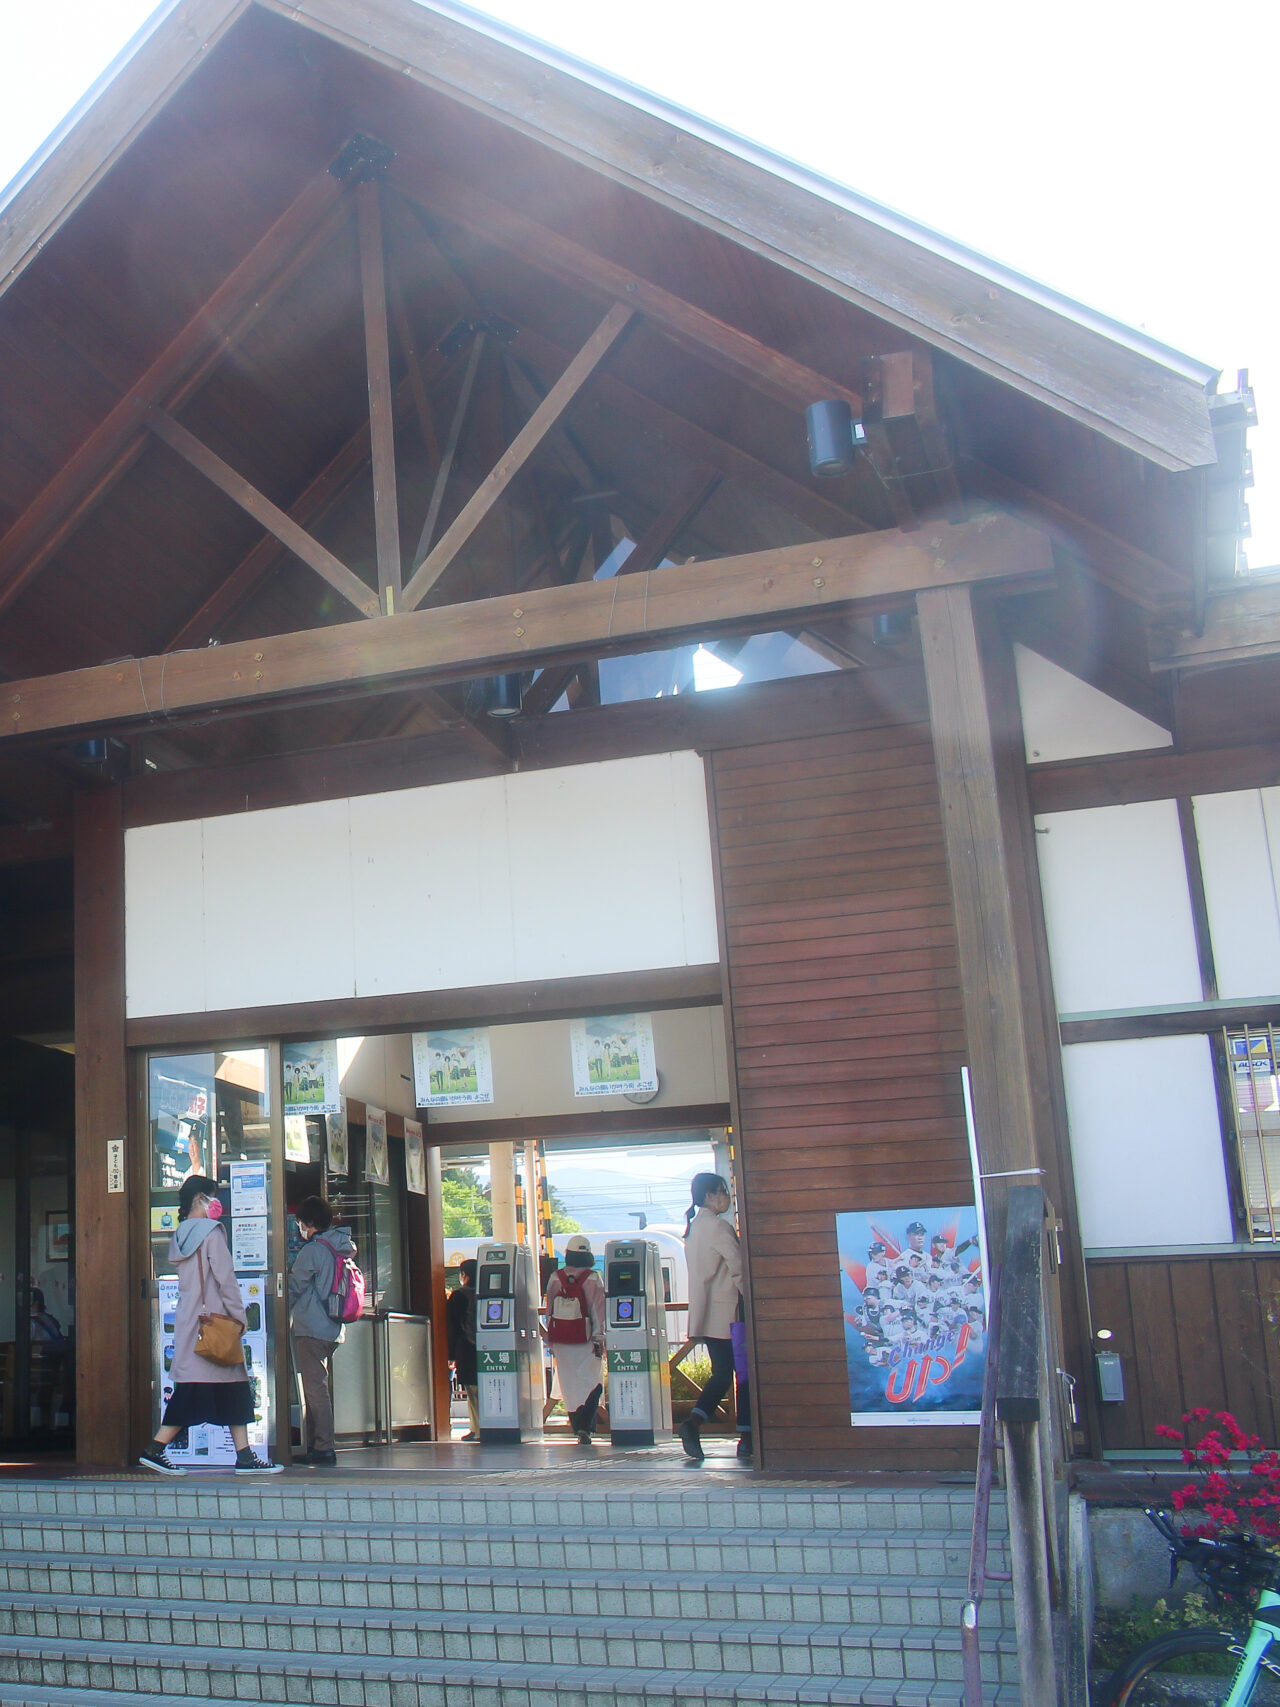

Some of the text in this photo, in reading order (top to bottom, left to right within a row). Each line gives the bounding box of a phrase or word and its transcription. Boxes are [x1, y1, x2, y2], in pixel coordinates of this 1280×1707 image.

[1238, 1060, 1268, 1068] ALOK
[887, 1330, 956, 1369] Change
[483, 1352, 510, 1364] 入場
[613, 1351, 642, 1364] 入場
